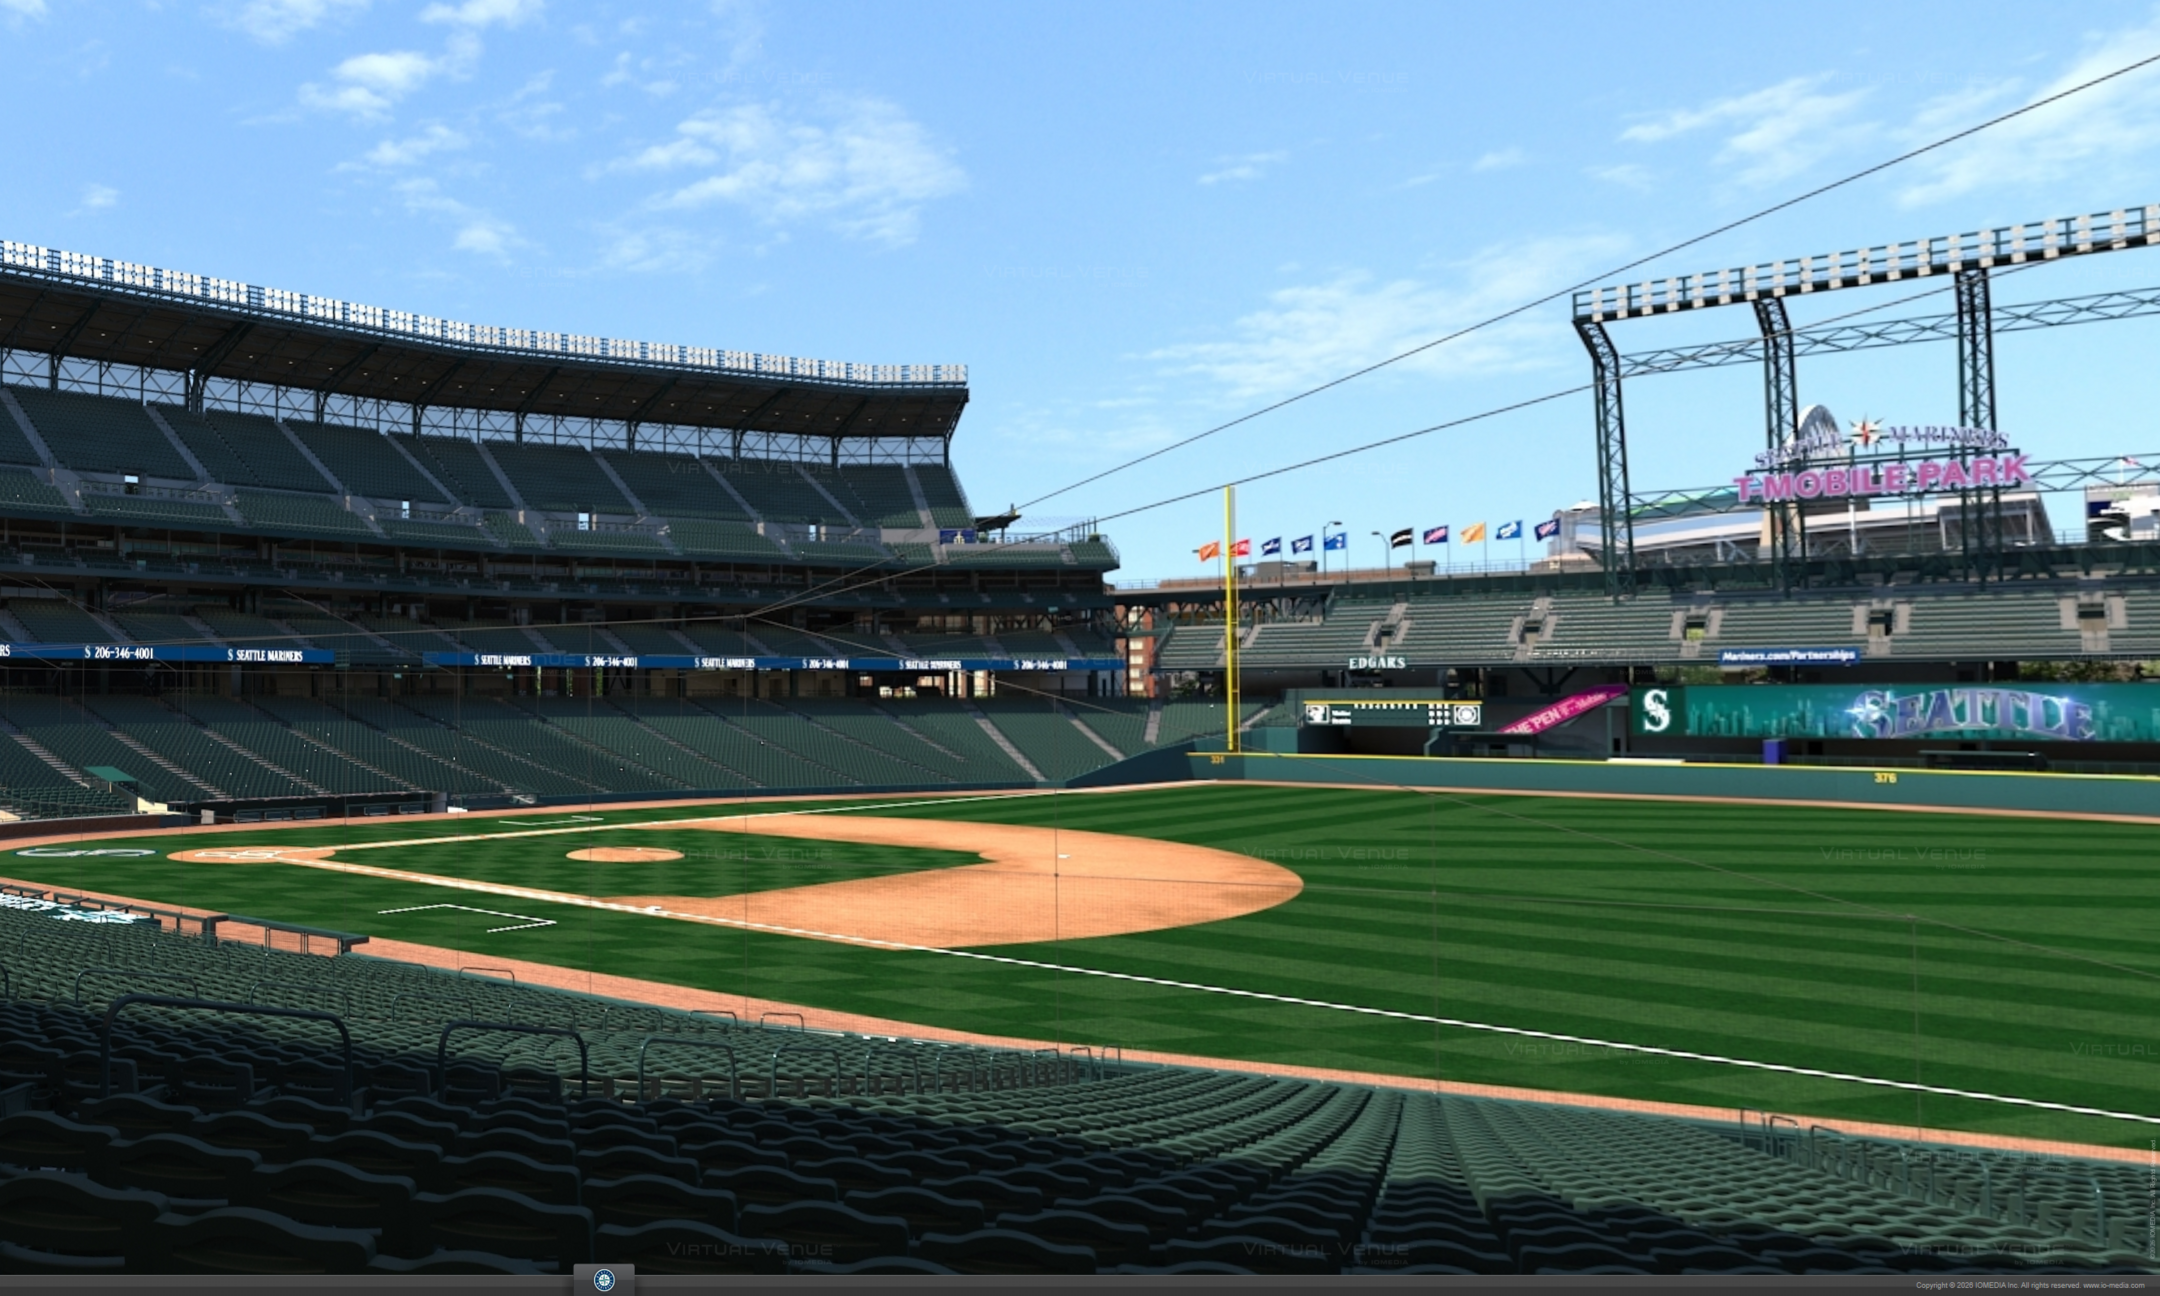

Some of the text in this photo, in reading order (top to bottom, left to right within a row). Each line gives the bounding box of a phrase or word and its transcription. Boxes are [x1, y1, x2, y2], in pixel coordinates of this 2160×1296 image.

[1734, 453, 2033, 502] T-MOBILE PARK
[95, 646, 154, 659] 206-346-4001
[236, 649, 266, 661] SEATTLE
[267, 650, 303, 662] MARINERS
[481, 655, 503, 665] SEATTLE
[503, 655, 531, 666] MARINERS
[701, 658, 725, 668] SEATTLE
[1852, 689, 2096, 740] SEATTLE
